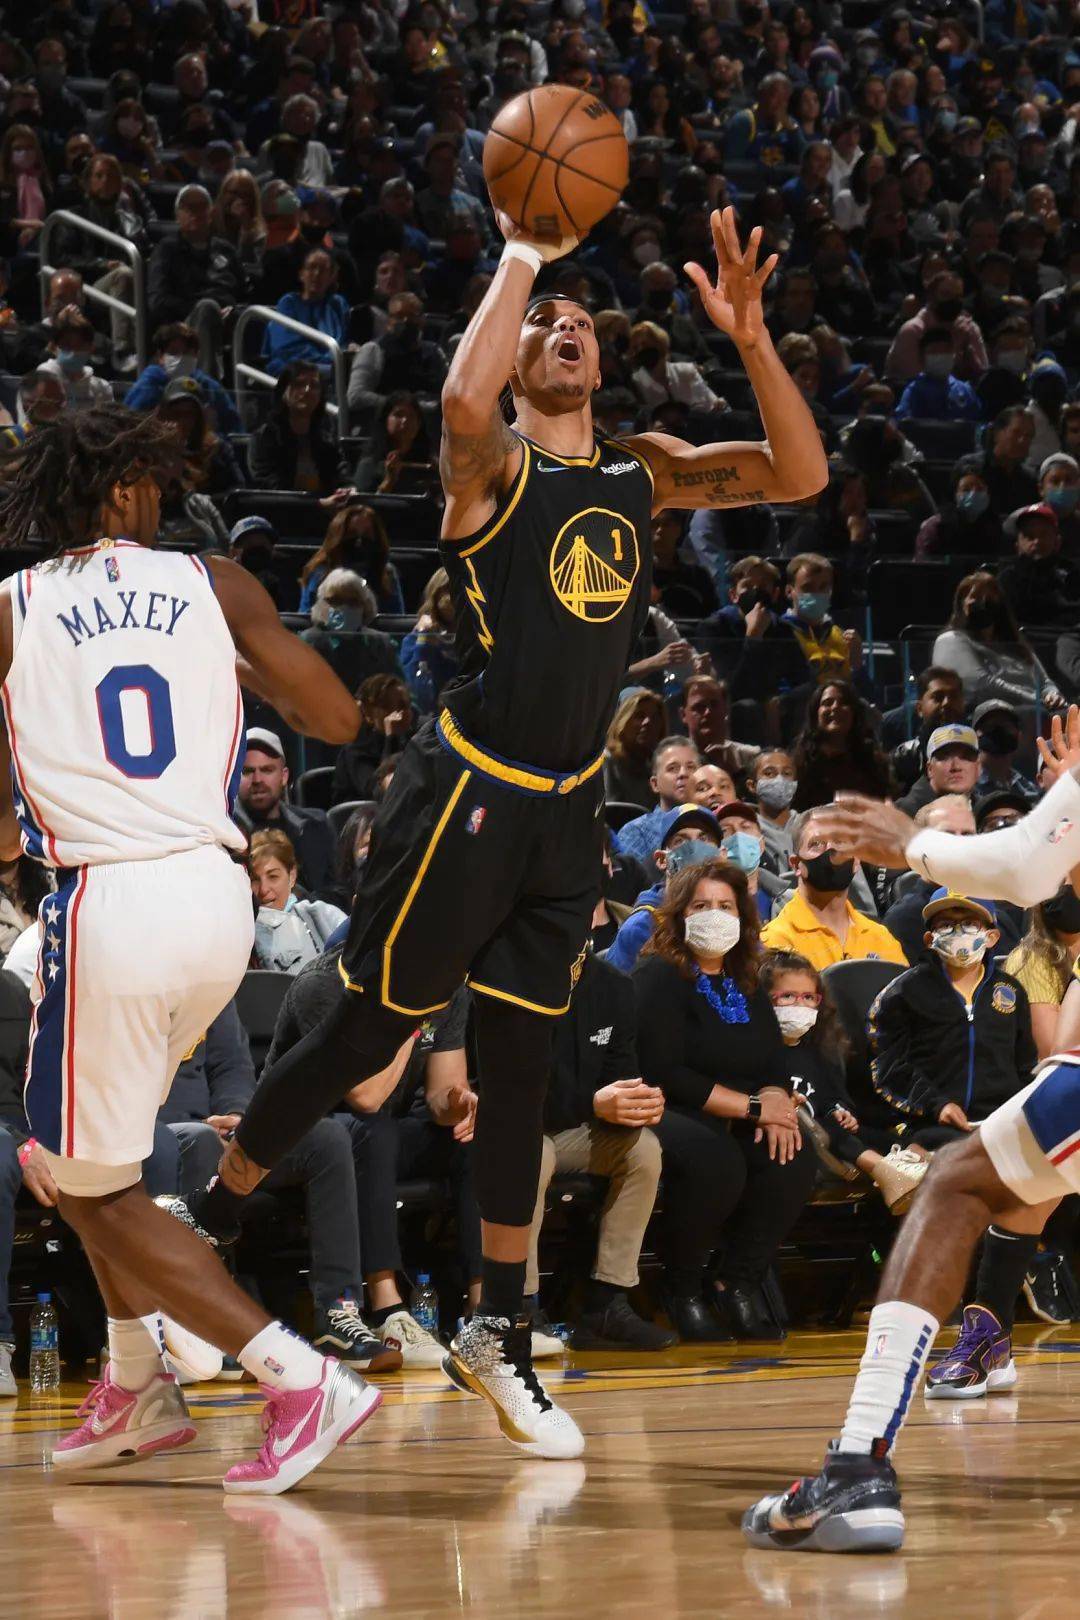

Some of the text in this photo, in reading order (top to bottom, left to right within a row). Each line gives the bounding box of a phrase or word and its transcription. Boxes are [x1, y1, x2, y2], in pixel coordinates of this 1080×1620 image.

[600, 460, 640, 476] Rakuten
[611, 528, 624, 561] 1
[56, 590, 191, 647] MAXEY
[95, 664, 177, 780] 0
